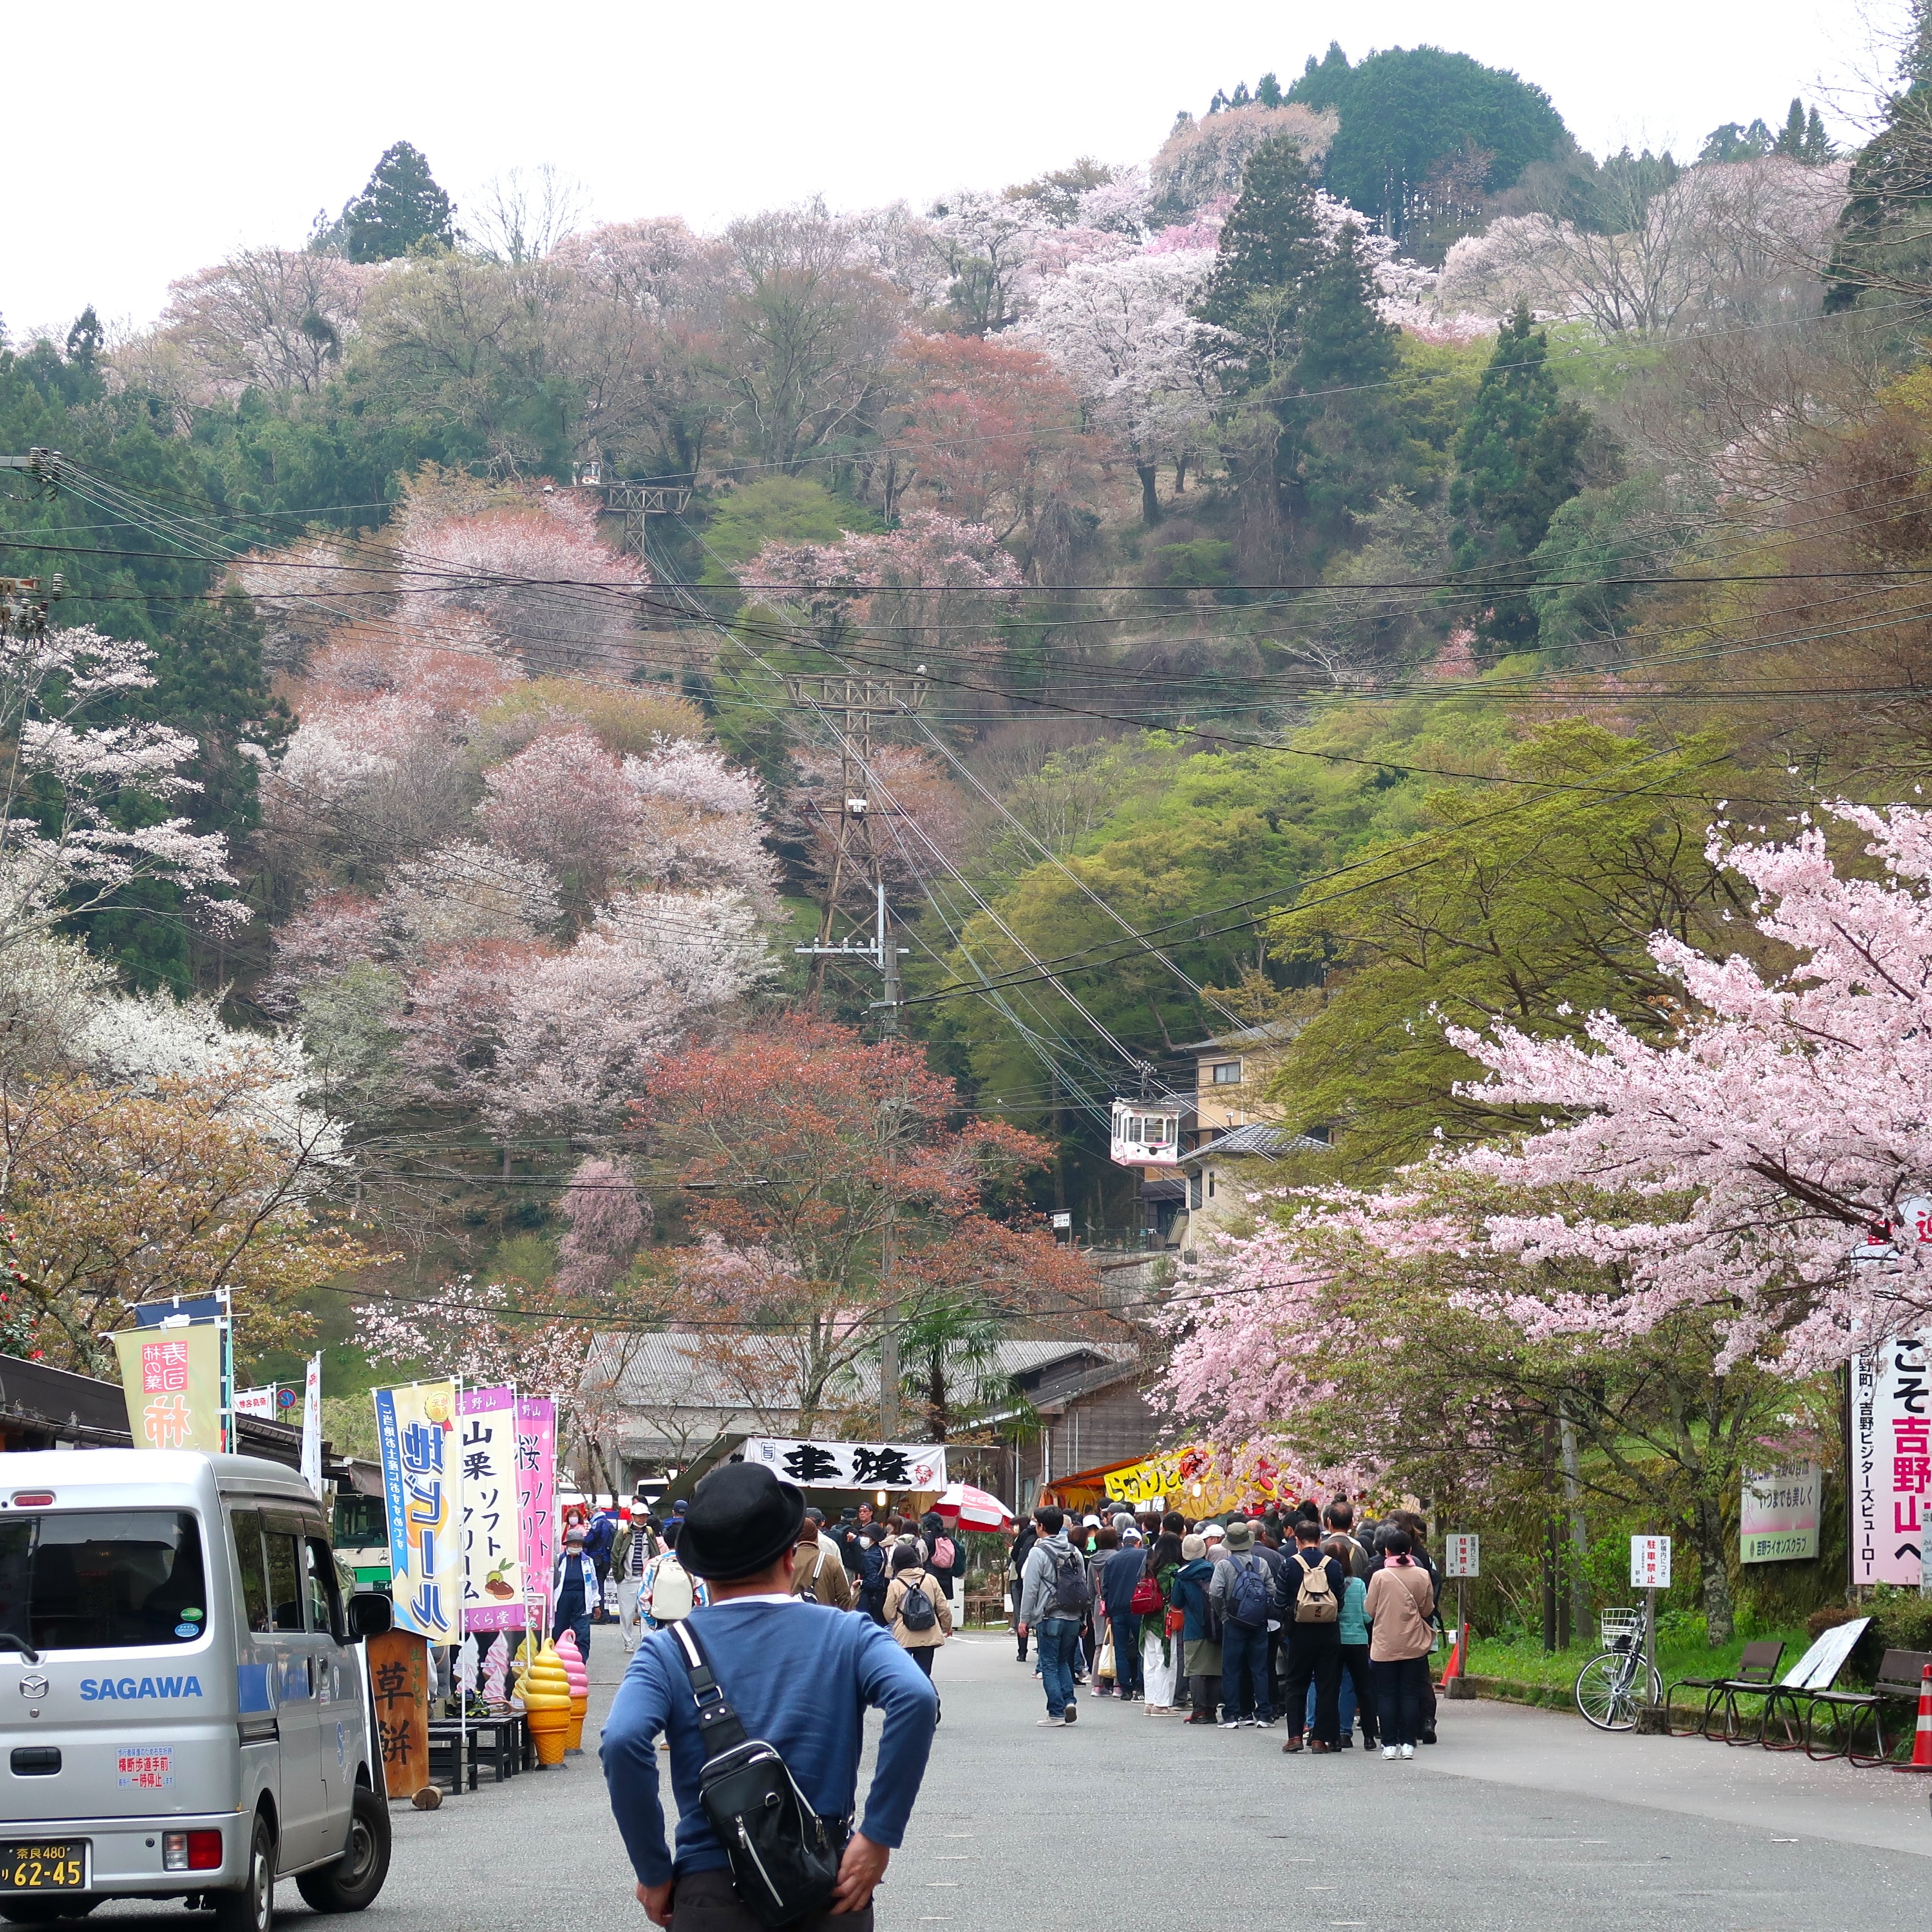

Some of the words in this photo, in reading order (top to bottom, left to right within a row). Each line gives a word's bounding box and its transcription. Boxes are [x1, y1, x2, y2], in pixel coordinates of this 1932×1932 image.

[514, 1434, 540, 1472] 桜
[480, 1488, 501, 1557] ソフト
[1647, 1540, 1656, 1584] 駐車禁止
[1757, 1537, 1807, 1556] 吉野ライオンズクラブ
[80, 1676, 203, 1701] SAGAWA
[14, 1861, 80, 1886] 62-45
